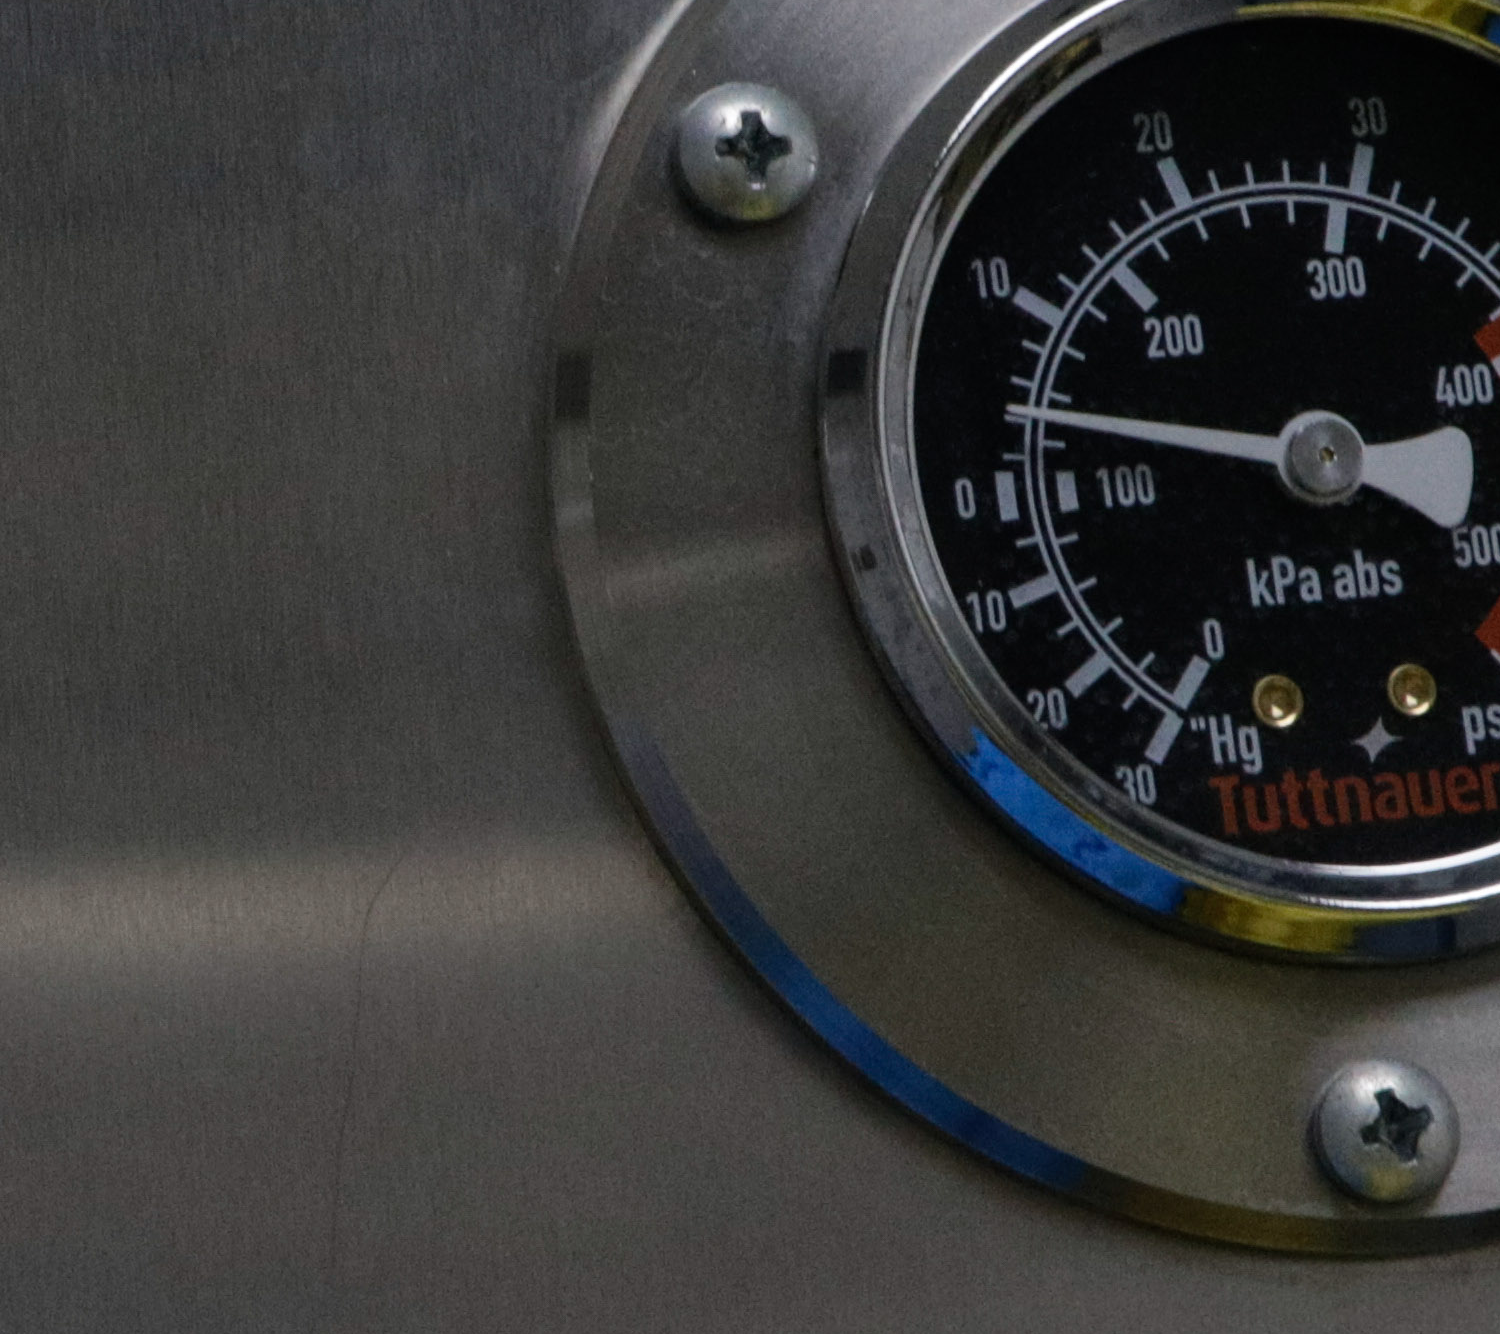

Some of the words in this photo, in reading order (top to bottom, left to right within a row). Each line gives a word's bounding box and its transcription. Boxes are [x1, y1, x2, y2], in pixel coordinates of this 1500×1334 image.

[1133, 110, 1174, 153] 20
[1348, 96, 1389, 137] 30
[970, 256, 1012, 300] 10
[1306, 256, 1366, 300] 300
[1144, 314, 1204, 358] 200
[1435, 364, 1494, 407] 400
[954, 478, 976, 520] 0
[1096, 464, 1156, 508] 100
[1246, 556, 1322, 608] kPa
[1333, 549, 1403, 600] abs
[1203, 618, 1225, 660] 0
